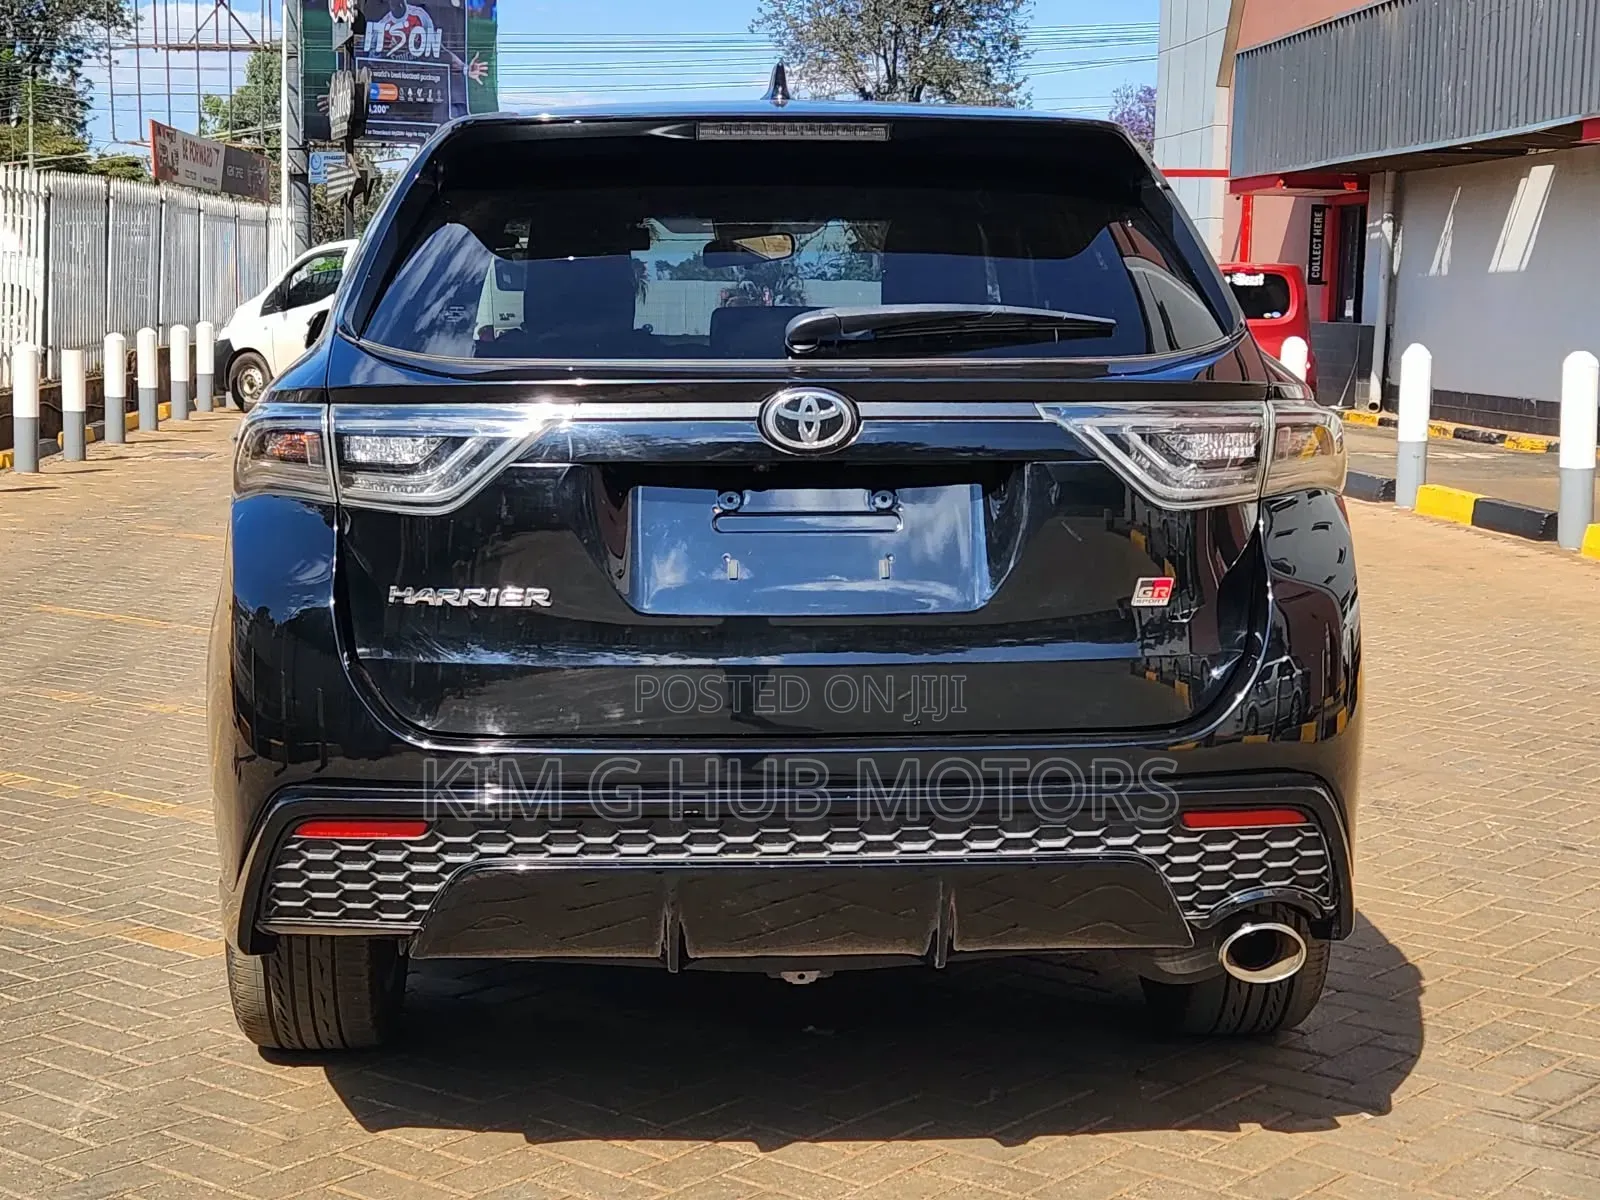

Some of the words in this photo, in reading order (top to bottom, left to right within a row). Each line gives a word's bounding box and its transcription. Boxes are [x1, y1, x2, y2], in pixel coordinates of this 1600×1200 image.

[408, 26, 443, 58] ON
[1313, 211, 1324, 236] HERE
[1311, 237, 1322, 279] COLLECT
[387, 584, 552, 607] HARRIER
[1138, 587, 1169, 598] GR
